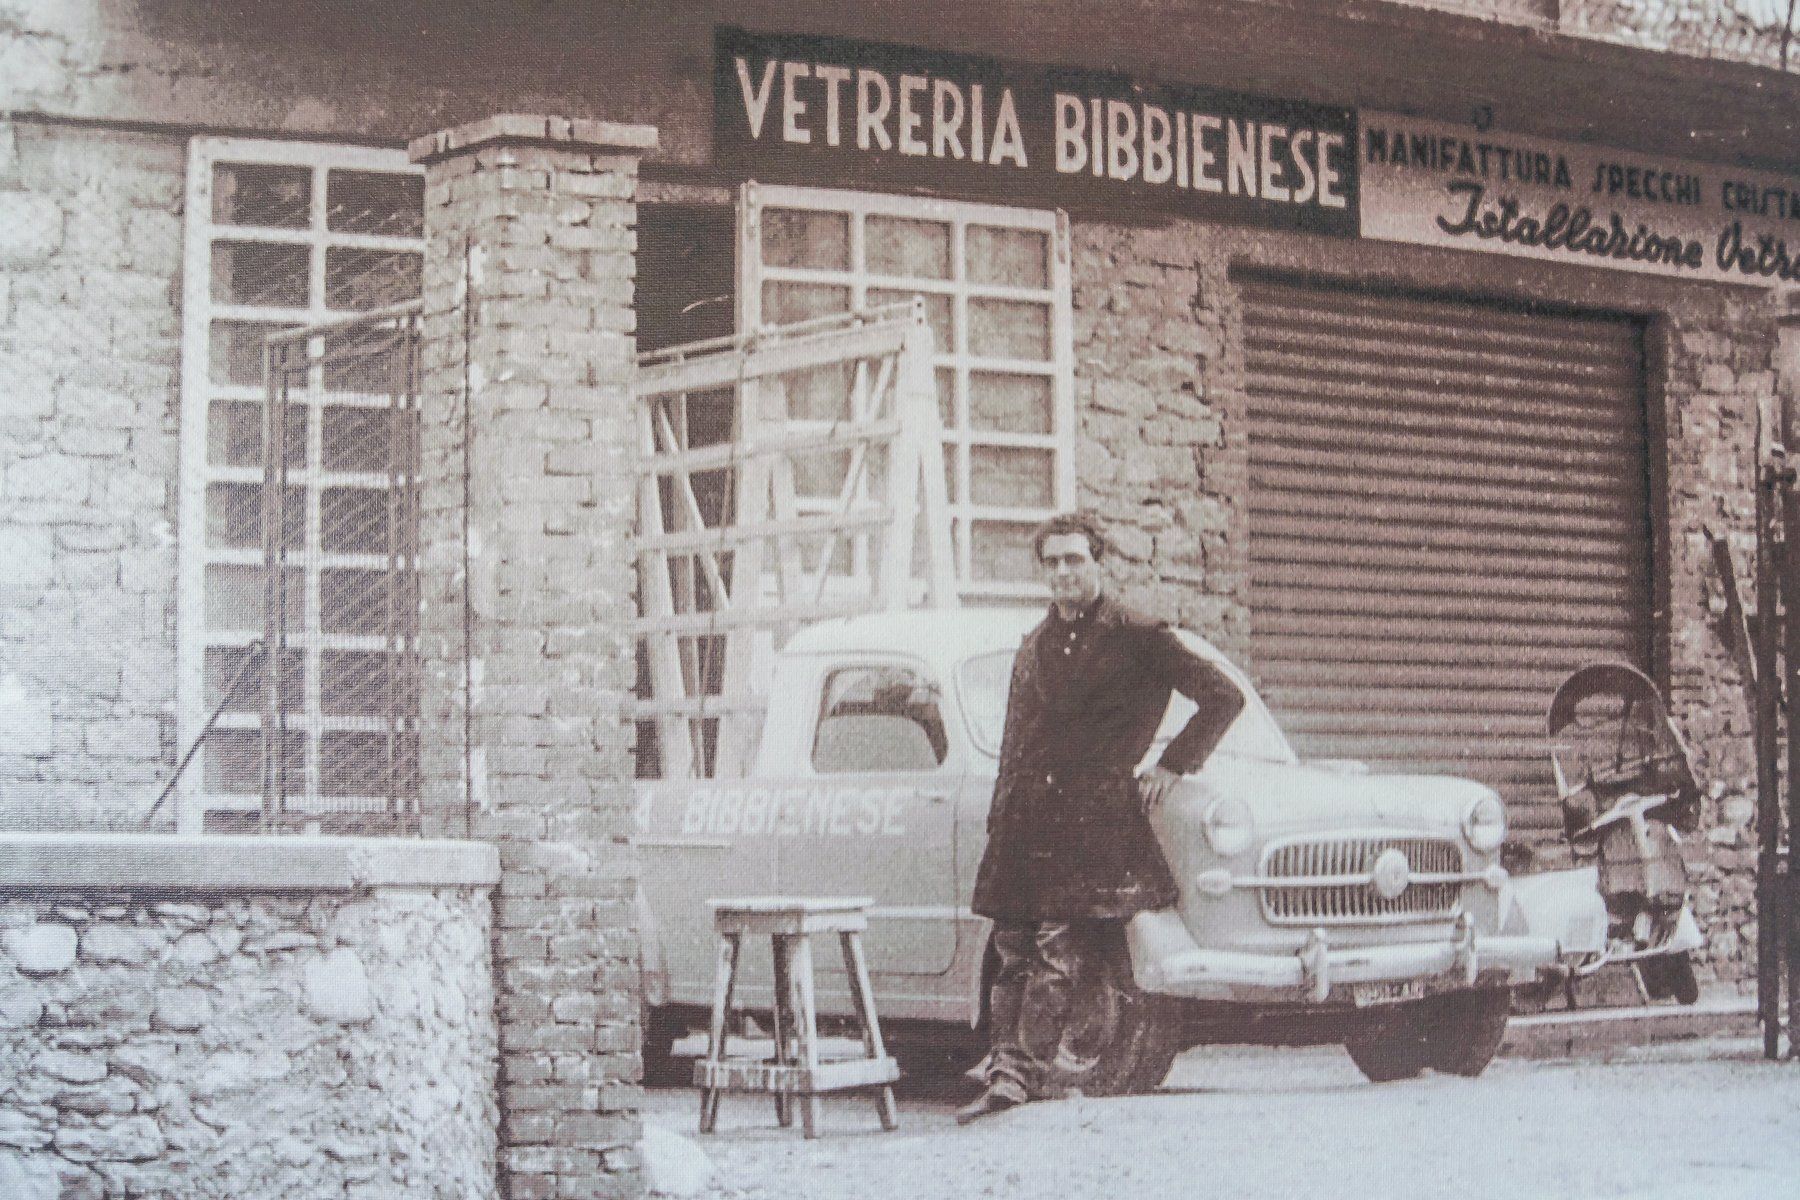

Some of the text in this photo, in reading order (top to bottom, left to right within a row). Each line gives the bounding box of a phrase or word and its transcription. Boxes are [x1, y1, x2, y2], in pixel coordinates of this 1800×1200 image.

[734, 57, 1347, 210] VETRERIA BIBBIENESE
[1366, 127, 1572, 191] MANIFATTURA
[1592, 161, 1701, 206] SPECCHI
[682, 785, 916, 836] BIBBIENESE
